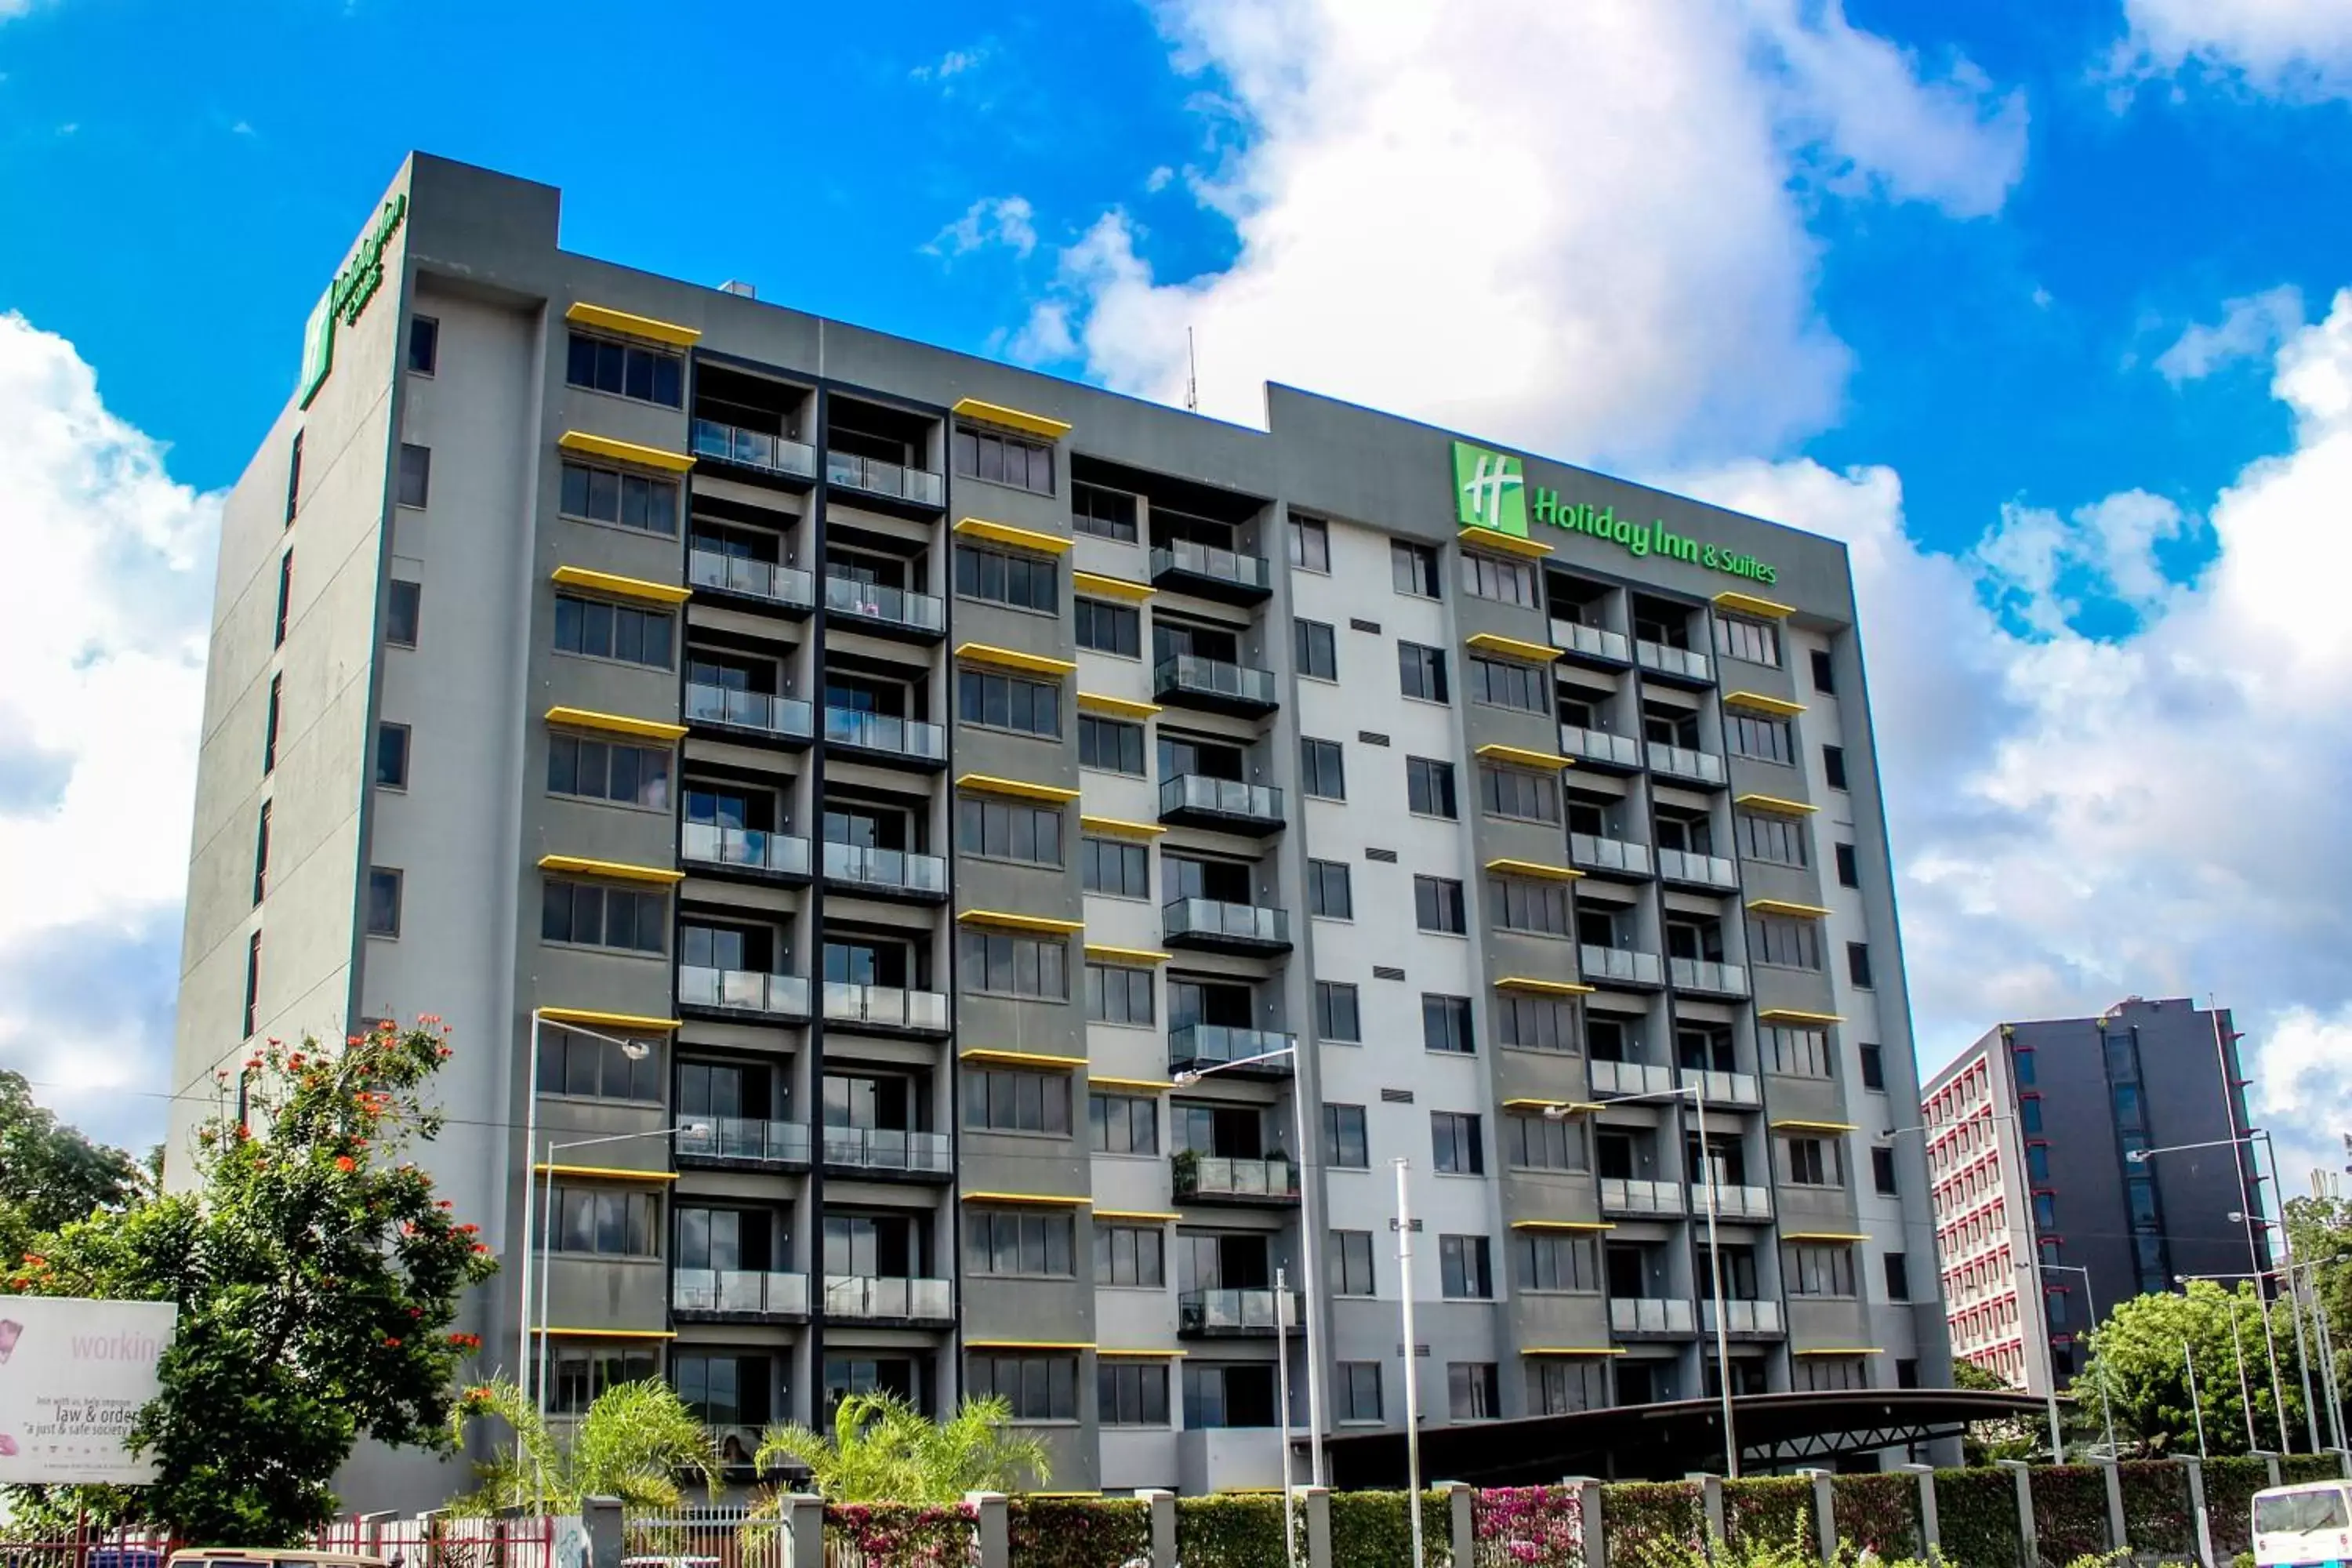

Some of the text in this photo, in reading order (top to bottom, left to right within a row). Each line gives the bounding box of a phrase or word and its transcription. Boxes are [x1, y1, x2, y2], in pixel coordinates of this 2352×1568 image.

[1533, 486, 1777, 586] Holiday Inn & Suites
[71, 1330, 162, 1362] workin
[56, 1405, 82, 1422] law
[86, 1405, 96, 1422] &
[35, 1424, 56, 1436] just
[93, 1425, 128, 1436] society
